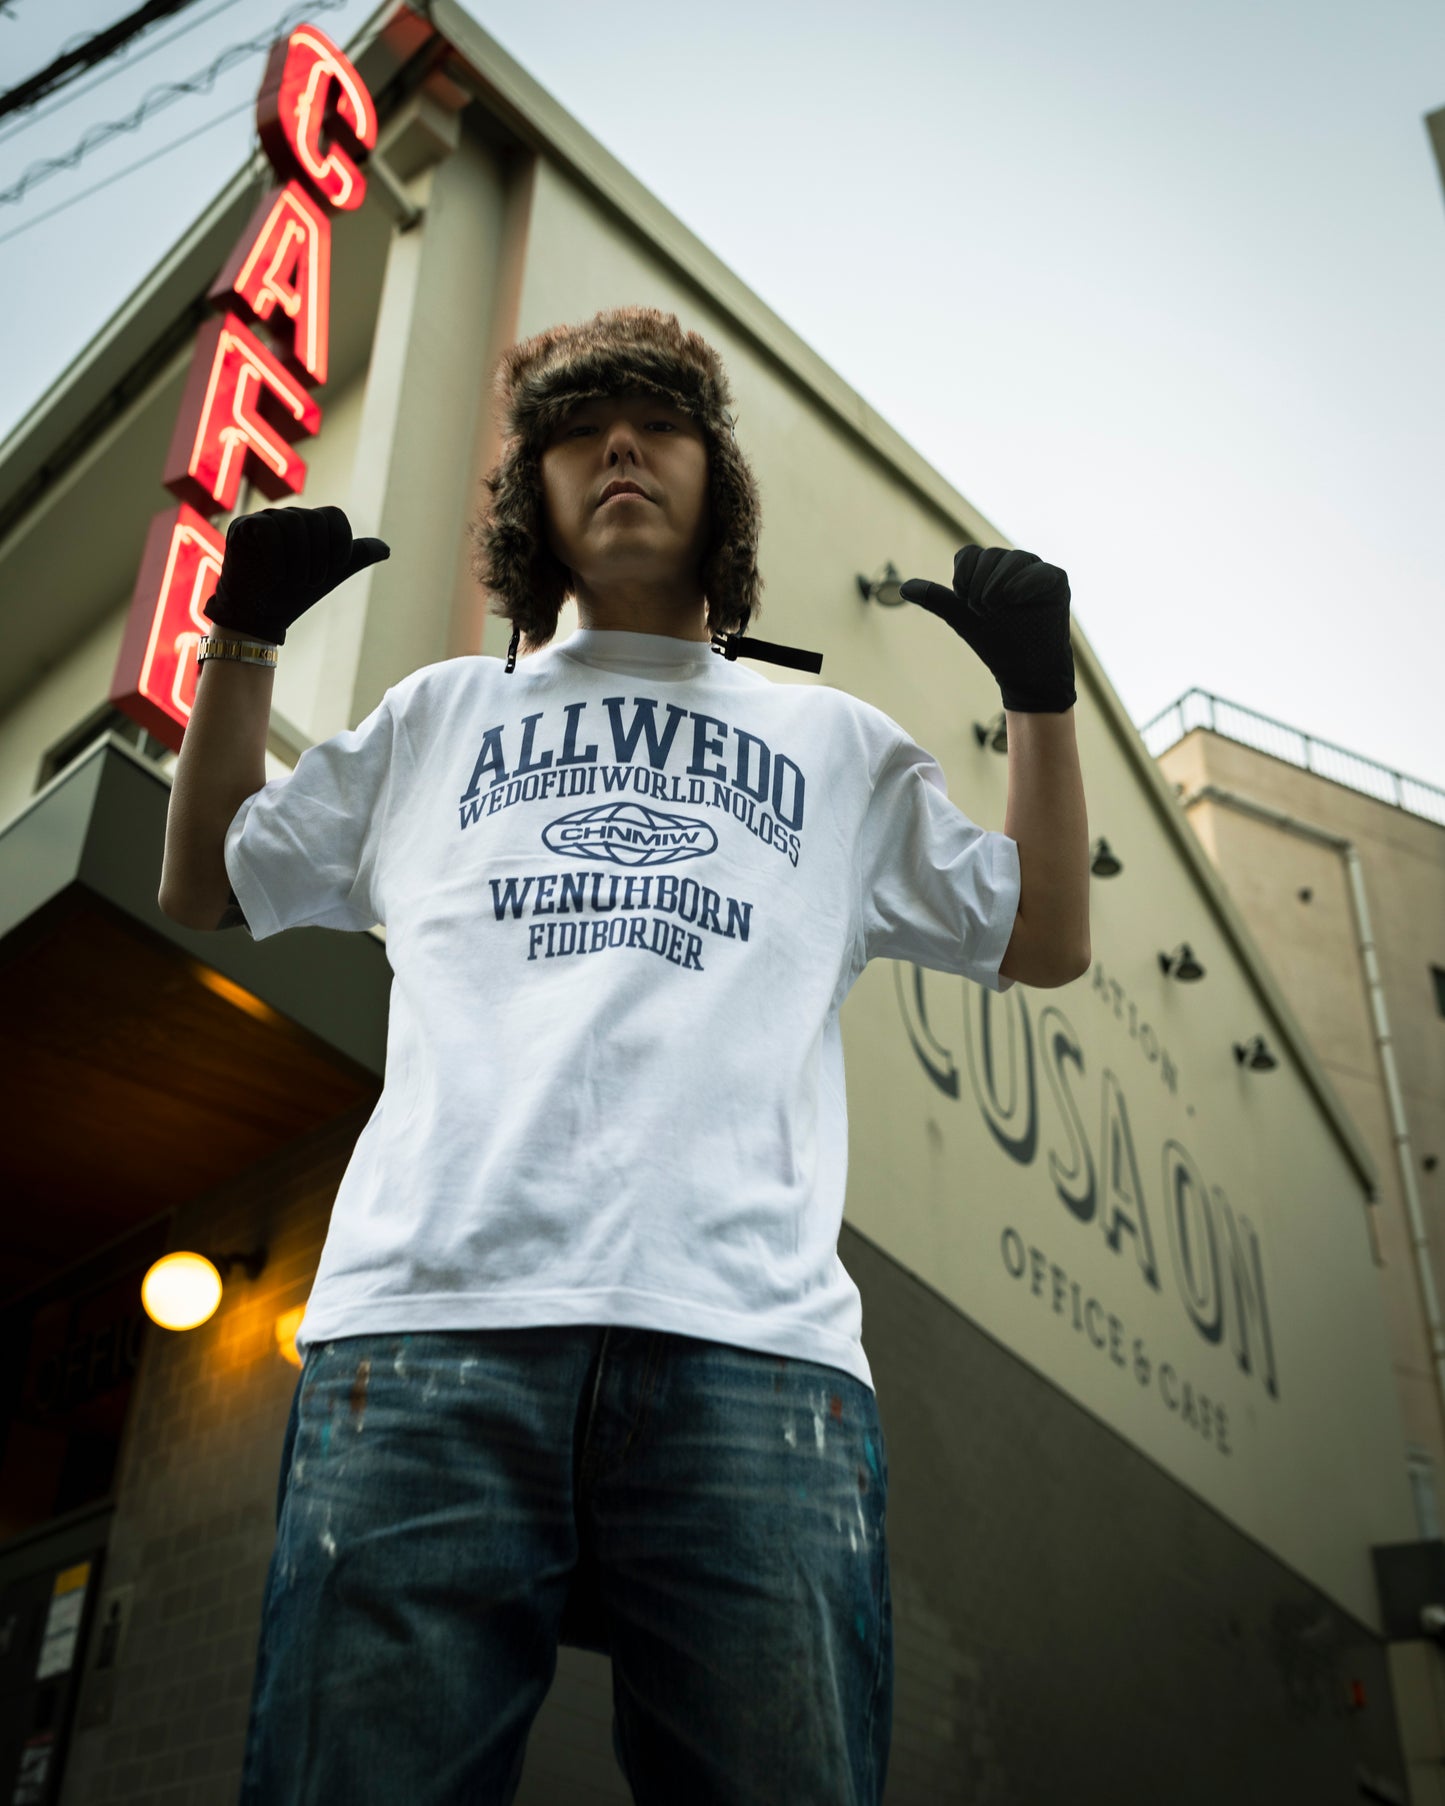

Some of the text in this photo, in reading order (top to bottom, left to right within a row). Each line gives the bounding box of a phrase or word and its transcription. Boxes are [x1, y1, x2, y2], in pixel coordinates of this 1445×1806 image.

[560, 815, 701, 846] CHNMIW
[488, 871, 753, 942] WENUHBORN
[527, 916, 704, 971] FIDIBORDER
[1001, 1226, 1126, 1369] OFFICE
